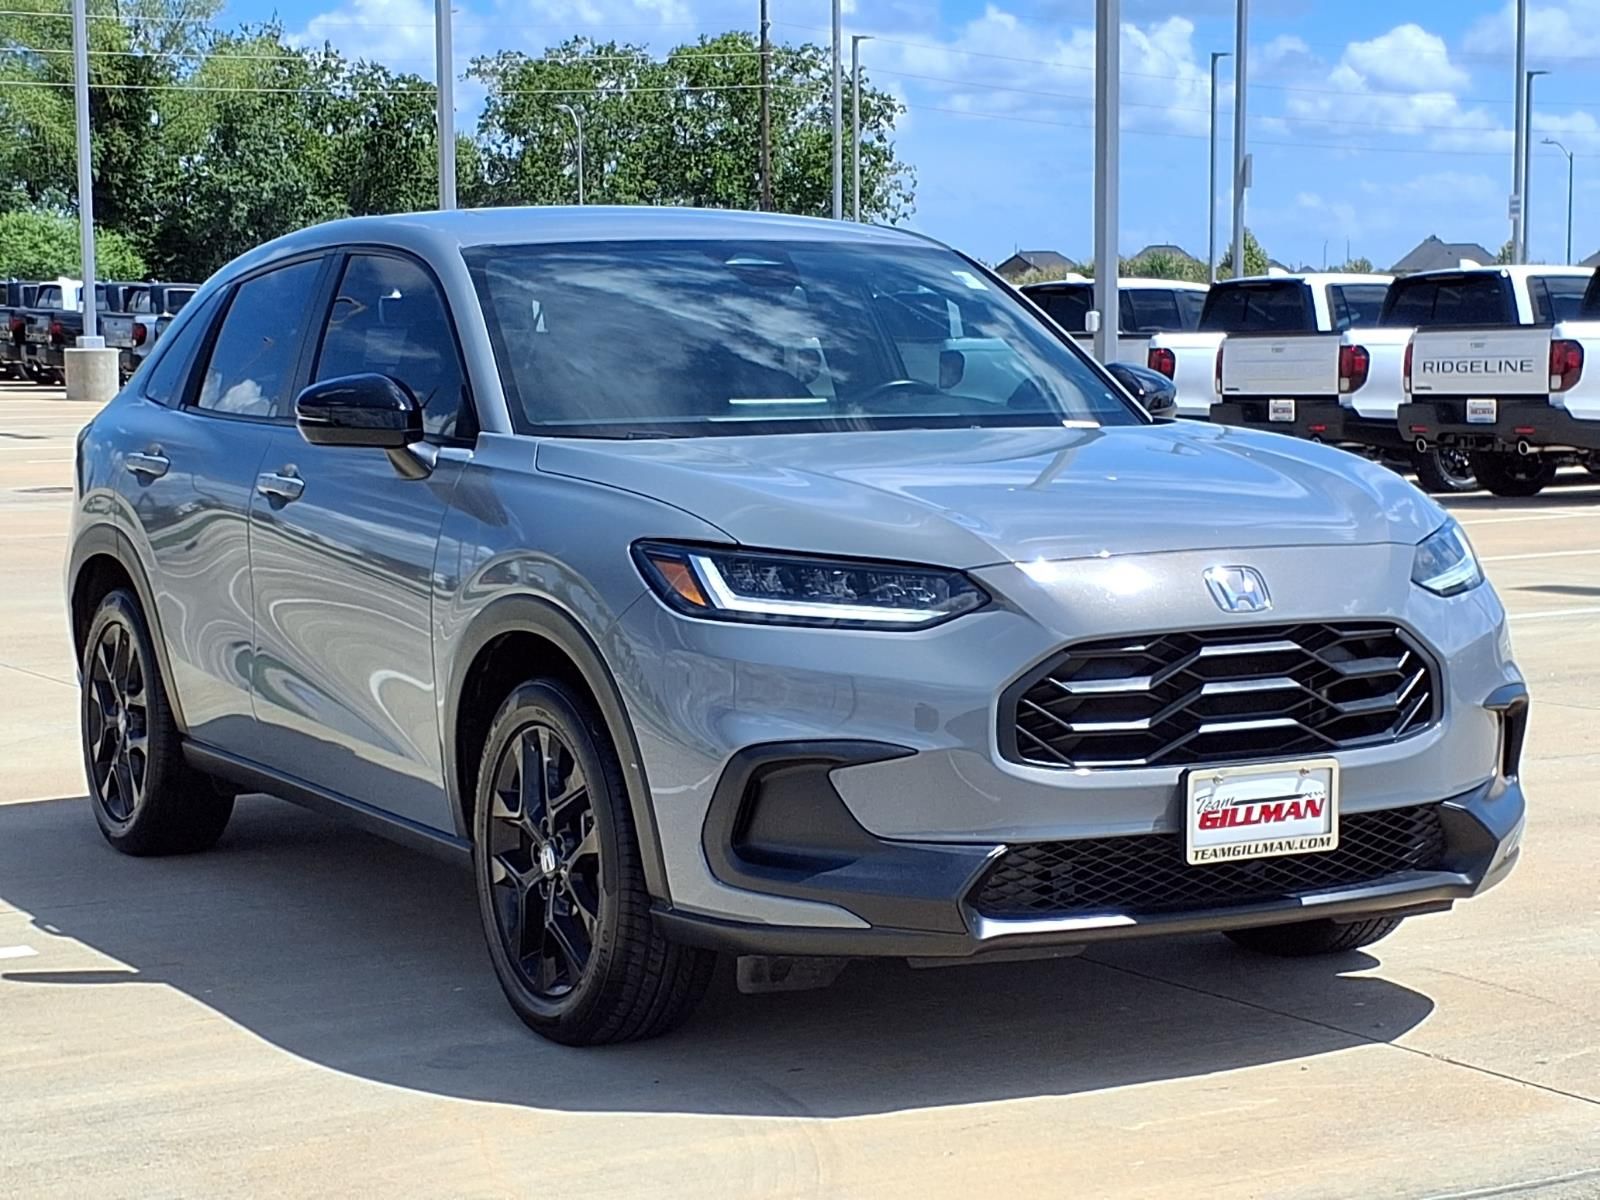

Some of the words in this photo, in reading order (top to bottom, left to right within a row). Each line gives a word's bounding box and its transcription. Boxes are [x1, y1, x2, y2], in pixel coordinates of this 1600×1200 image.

[1422, 360, 1534, 374] RIDGELINE
[1196, 793, 1235, 814] Team
[1198, 798, 1325, 830] GILLMAN
[1193, 837, 1331, 861] TEAMGILLMAN.COM
